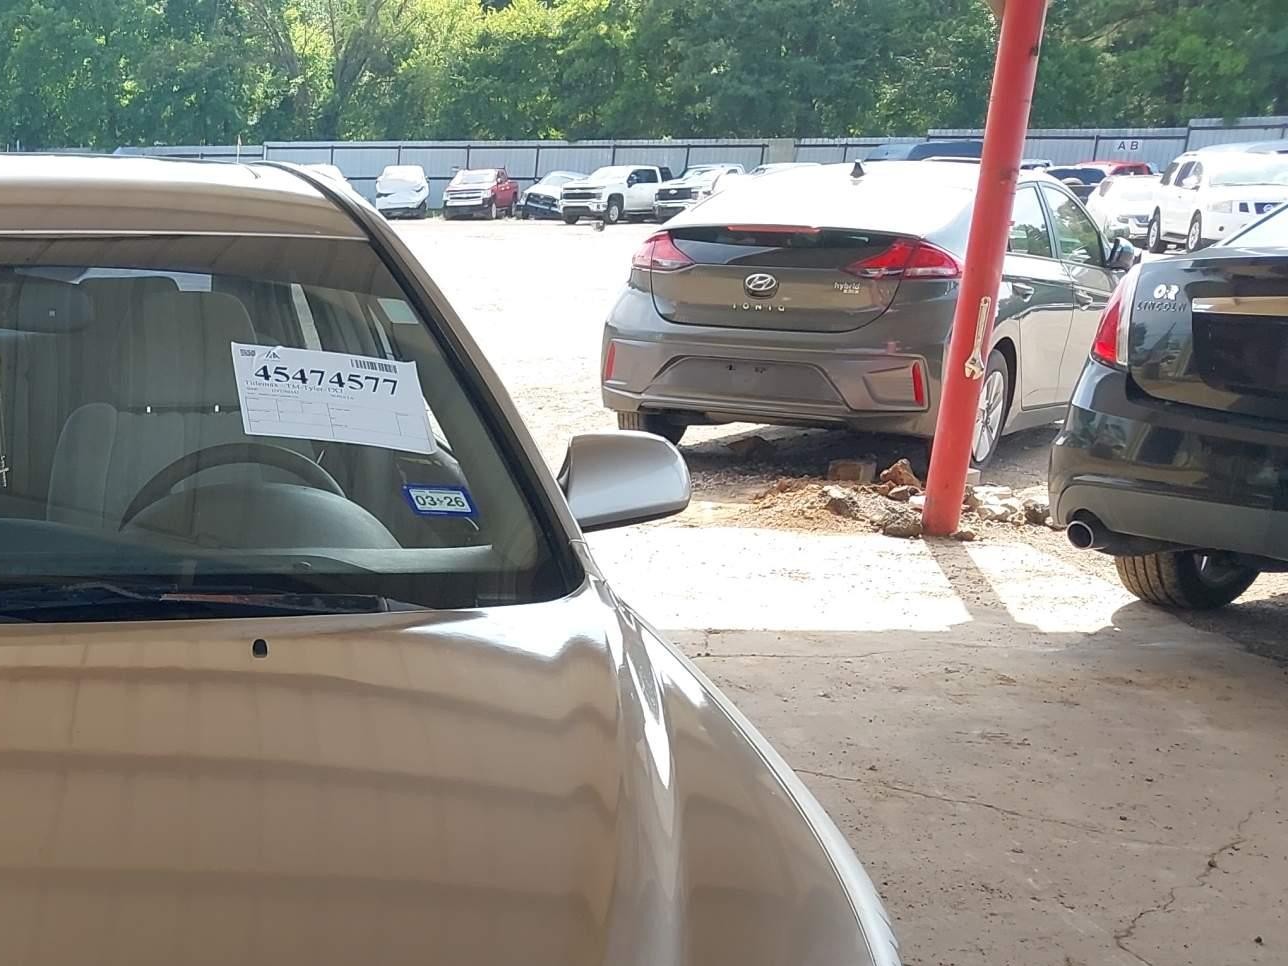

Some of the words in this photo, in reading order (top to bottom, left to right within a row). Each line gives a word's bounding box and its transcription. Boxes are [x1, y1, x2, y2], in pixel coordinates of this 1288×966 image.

[1118, 141, 1126, 150] A
[1130, 141, 1139, 150] B
[732, 302, 785, 311] IONIQ
[1136, 300, 1187, 312] LINCOLN
[254, 364, 398, 396] 45474577
